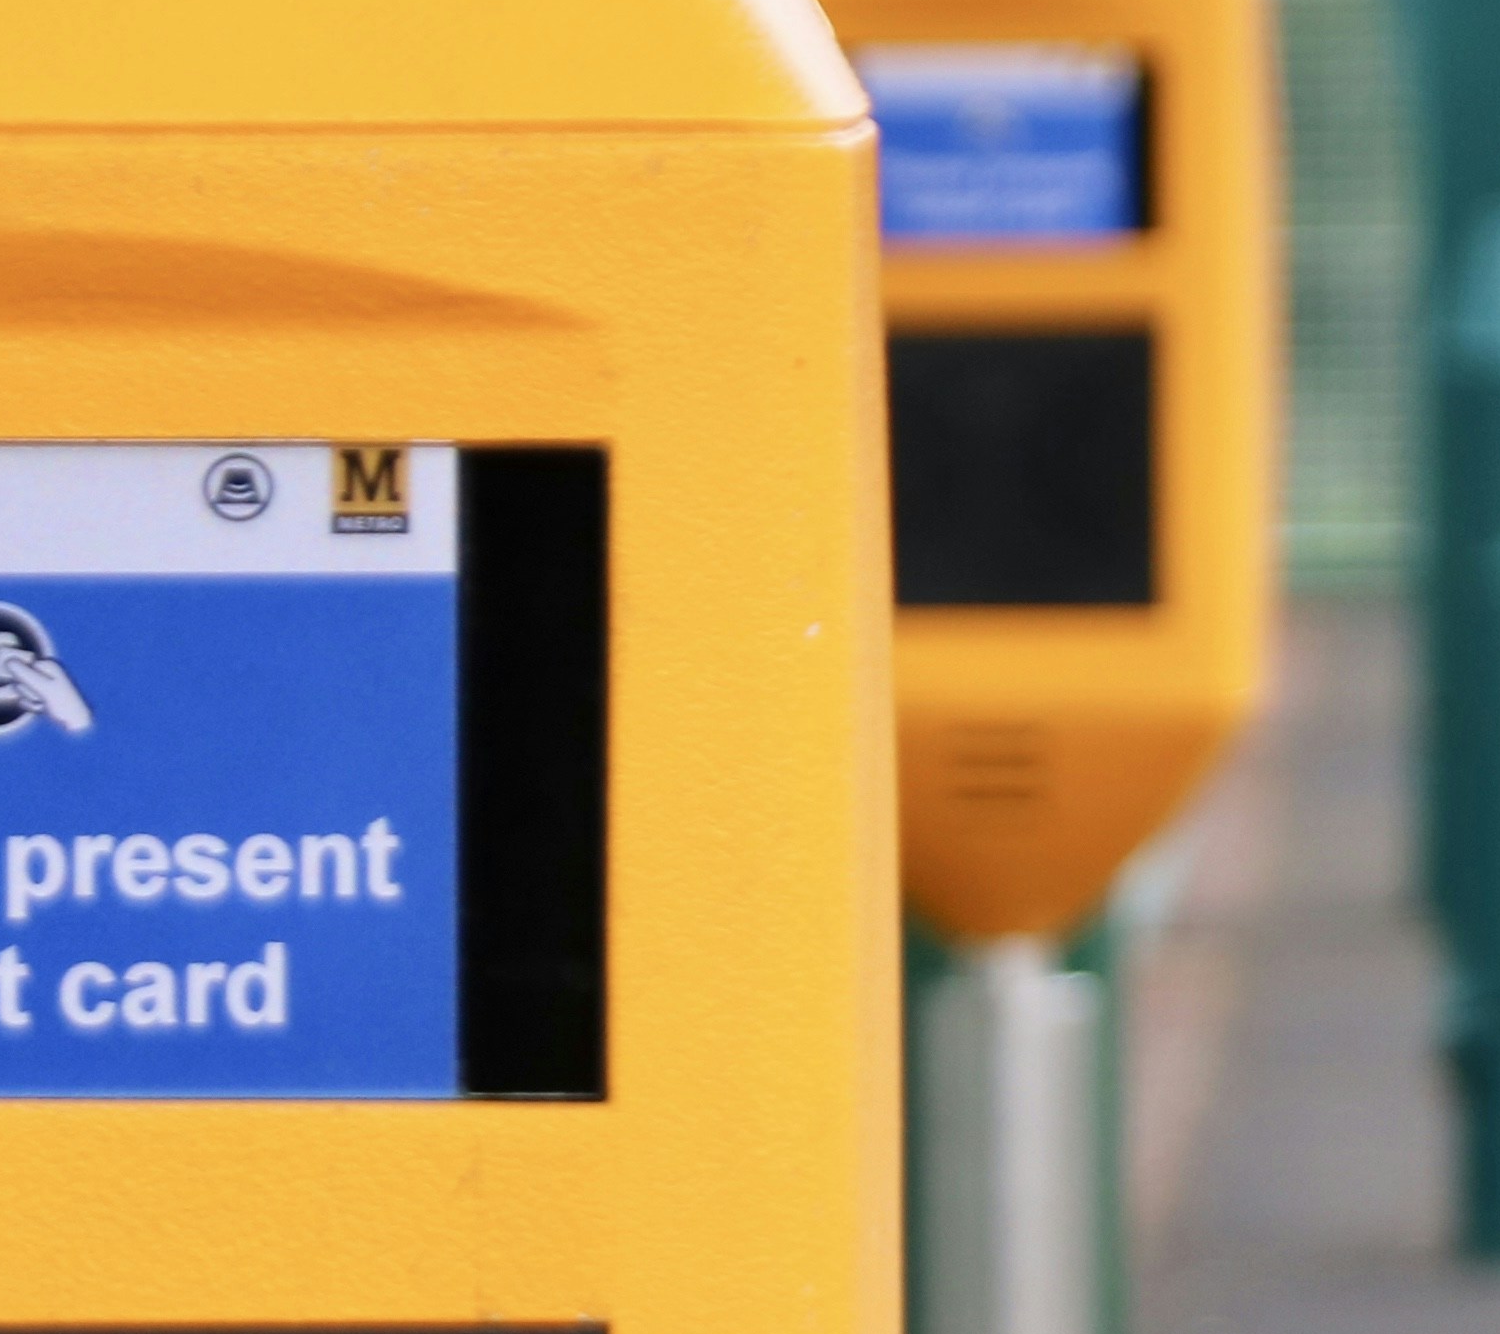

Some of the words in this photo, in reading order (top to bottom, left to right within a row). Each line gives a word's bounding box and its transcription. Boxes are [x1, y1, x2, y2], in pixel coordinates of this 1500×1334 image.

[341, 449, 401, 502] M
[5, 816, 402, 922] present
[59, 942, 287, 1030] card
